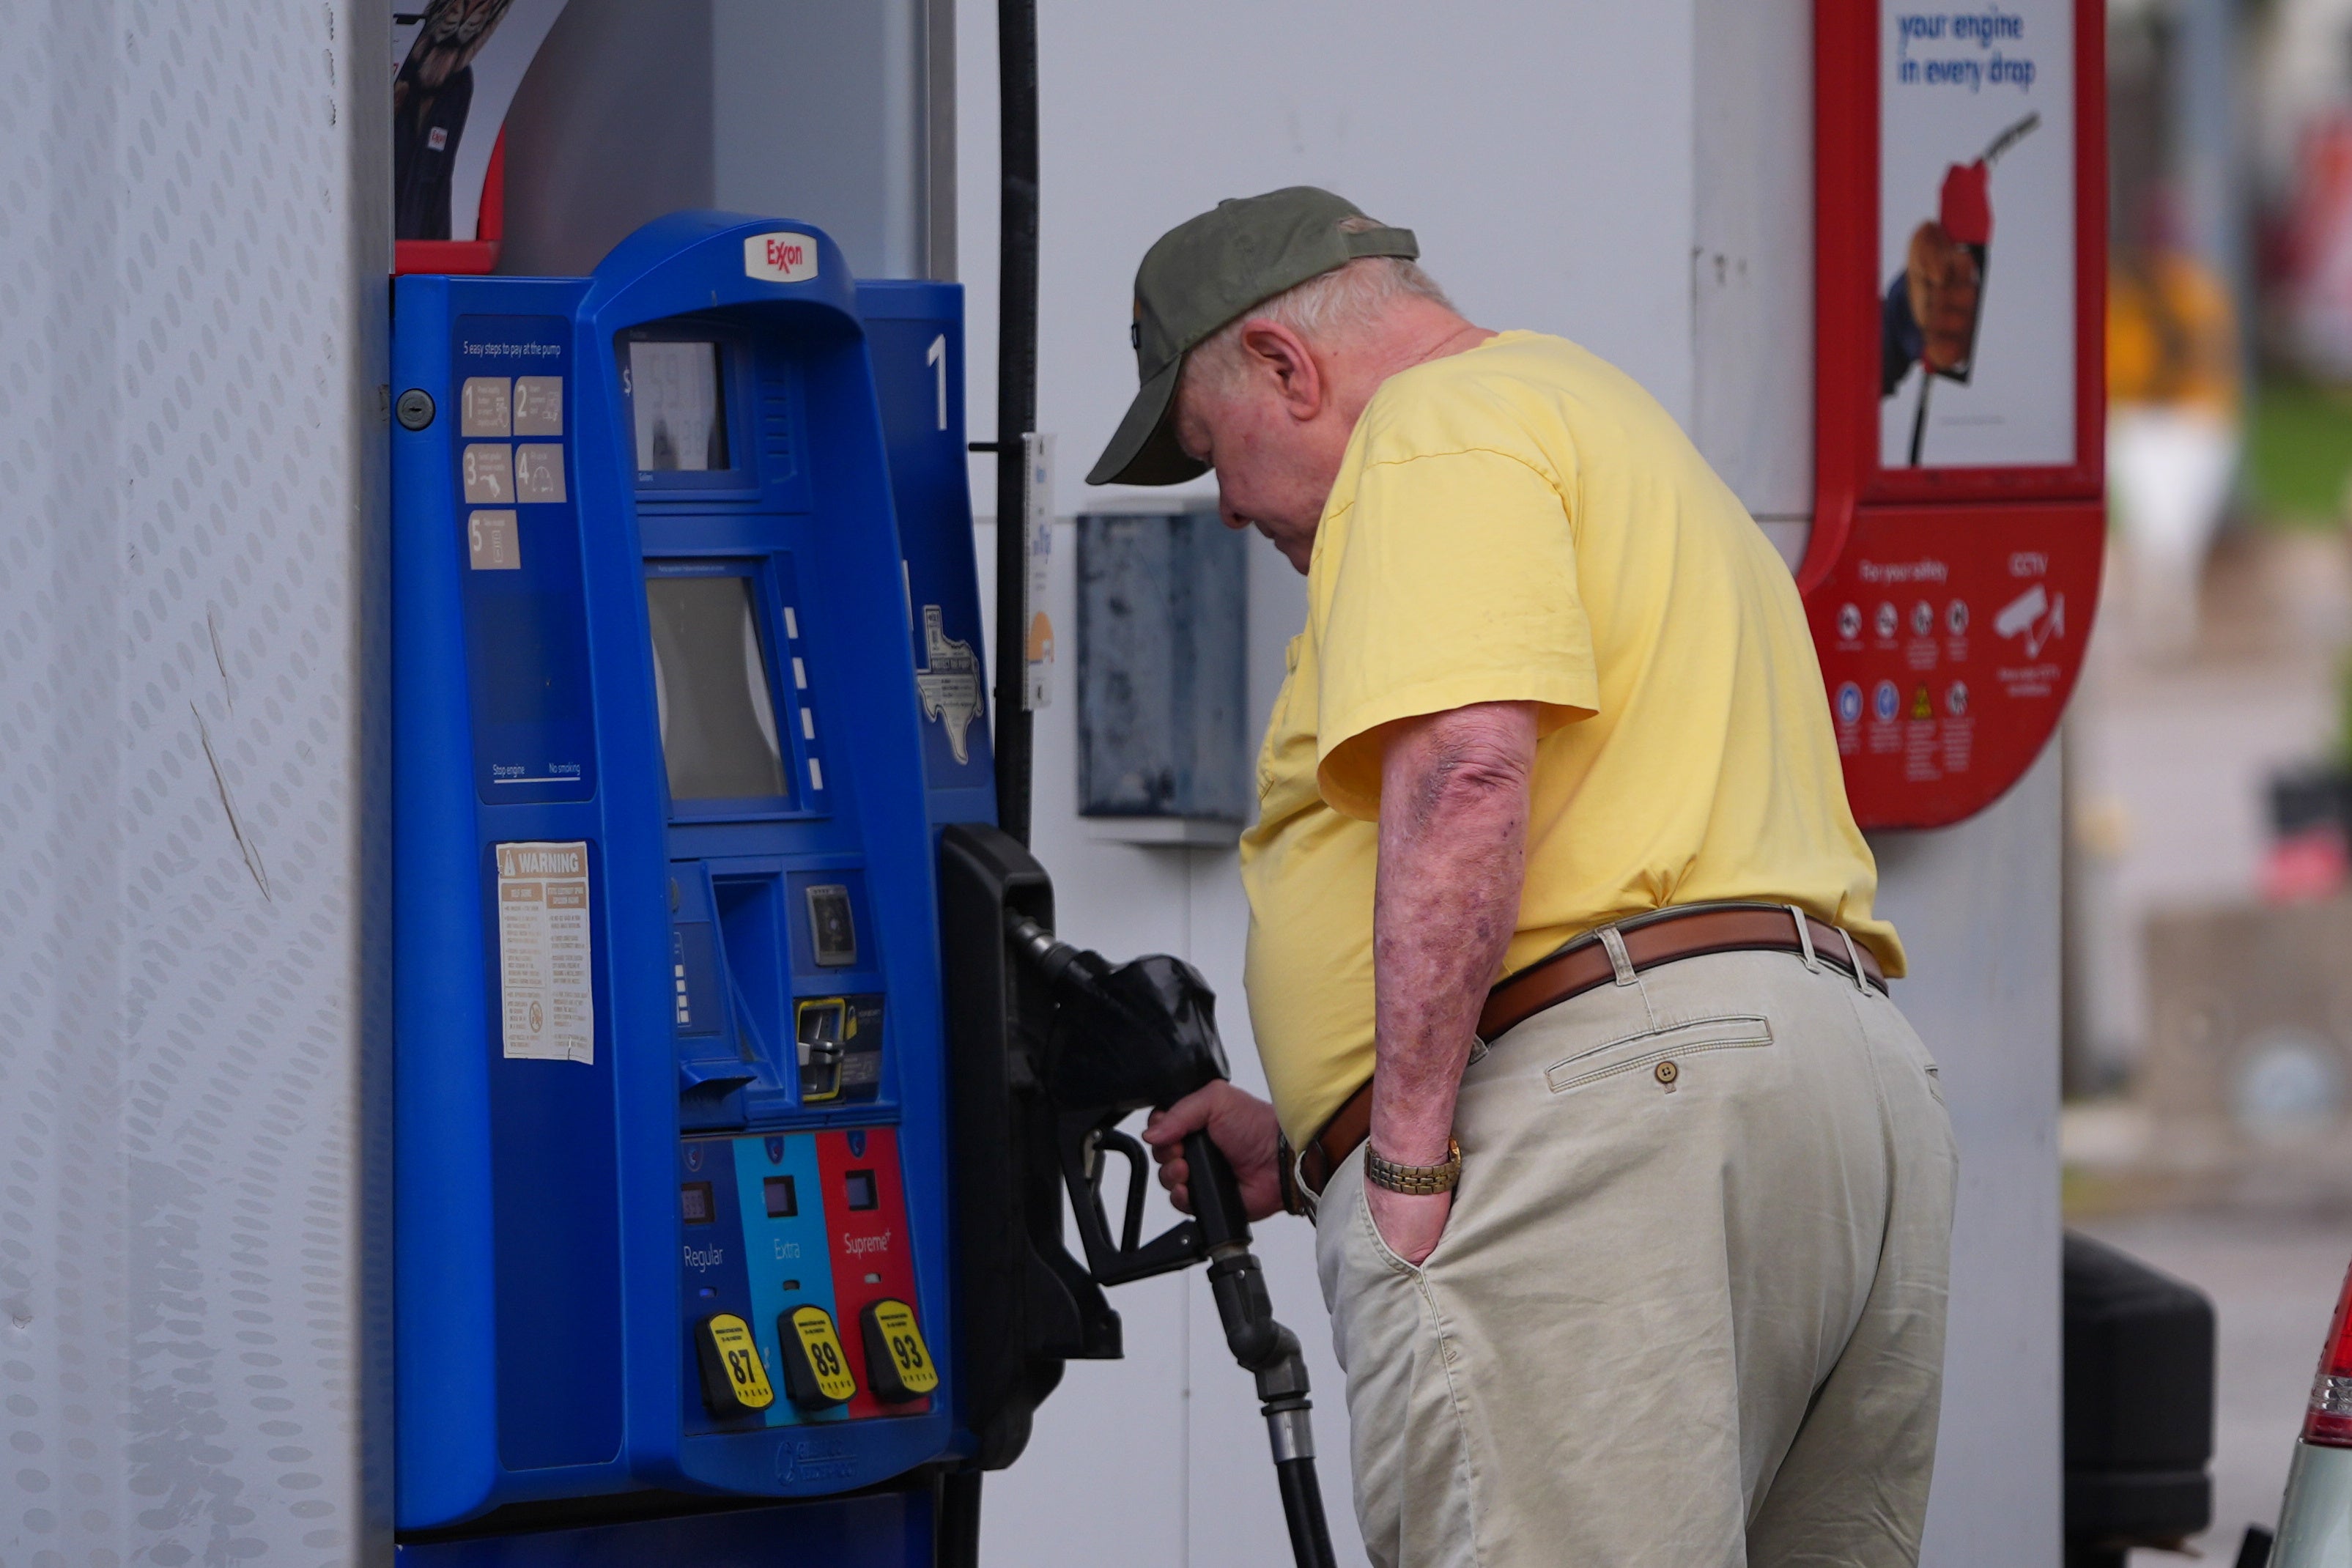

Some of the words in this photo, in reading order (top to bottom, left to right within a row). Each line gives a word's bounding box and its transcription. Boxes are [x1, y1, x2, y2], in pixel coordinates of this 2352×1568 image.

[1897, 14, 1947, 48] your
[1953, 4, 2024, 48] engine
[1899, 51, 1920, 84] in
[1926, 60, 1981, 94] every
[1989, 51, 2036, 95] drop
[766, 240, 802, 274] Exxon
[464, 341, 468, 355] 5
[469, 344, 484, 358] easy
[484, 342, 502, 358] steps
[503, 343, 509, 355] to
[511, 344, 522, 358] pay
[523, 343, 530, 355] at
[530, 341, 541, 355] the
[542, 345, 561, 358] pump
[623, 366, 632, 397] $
[927, 333, 947, 431] 1
[465, 385, 473, 419] 1
[517, 385, 527, 418] 2
[467, 452, 476, 486] 3
[519, 452, 530, 484] 4
[472, 519, 482, 552] 5
[492, 763, 506, 777] Stop
[506, 764, 525, 777] engine
[549, 763, 558, 774] No
[558, 762, 580, 776] smoking
[518, 852, 579, 873] WARNING
[684, 1243, 723, 1273] Regular
[774, 1238, 800, 1260] Extra
[728, 1349, 755, 1385] 87
[811, 1342, 840, 1377] 89
[892, 1334, 923, 1369] 93
